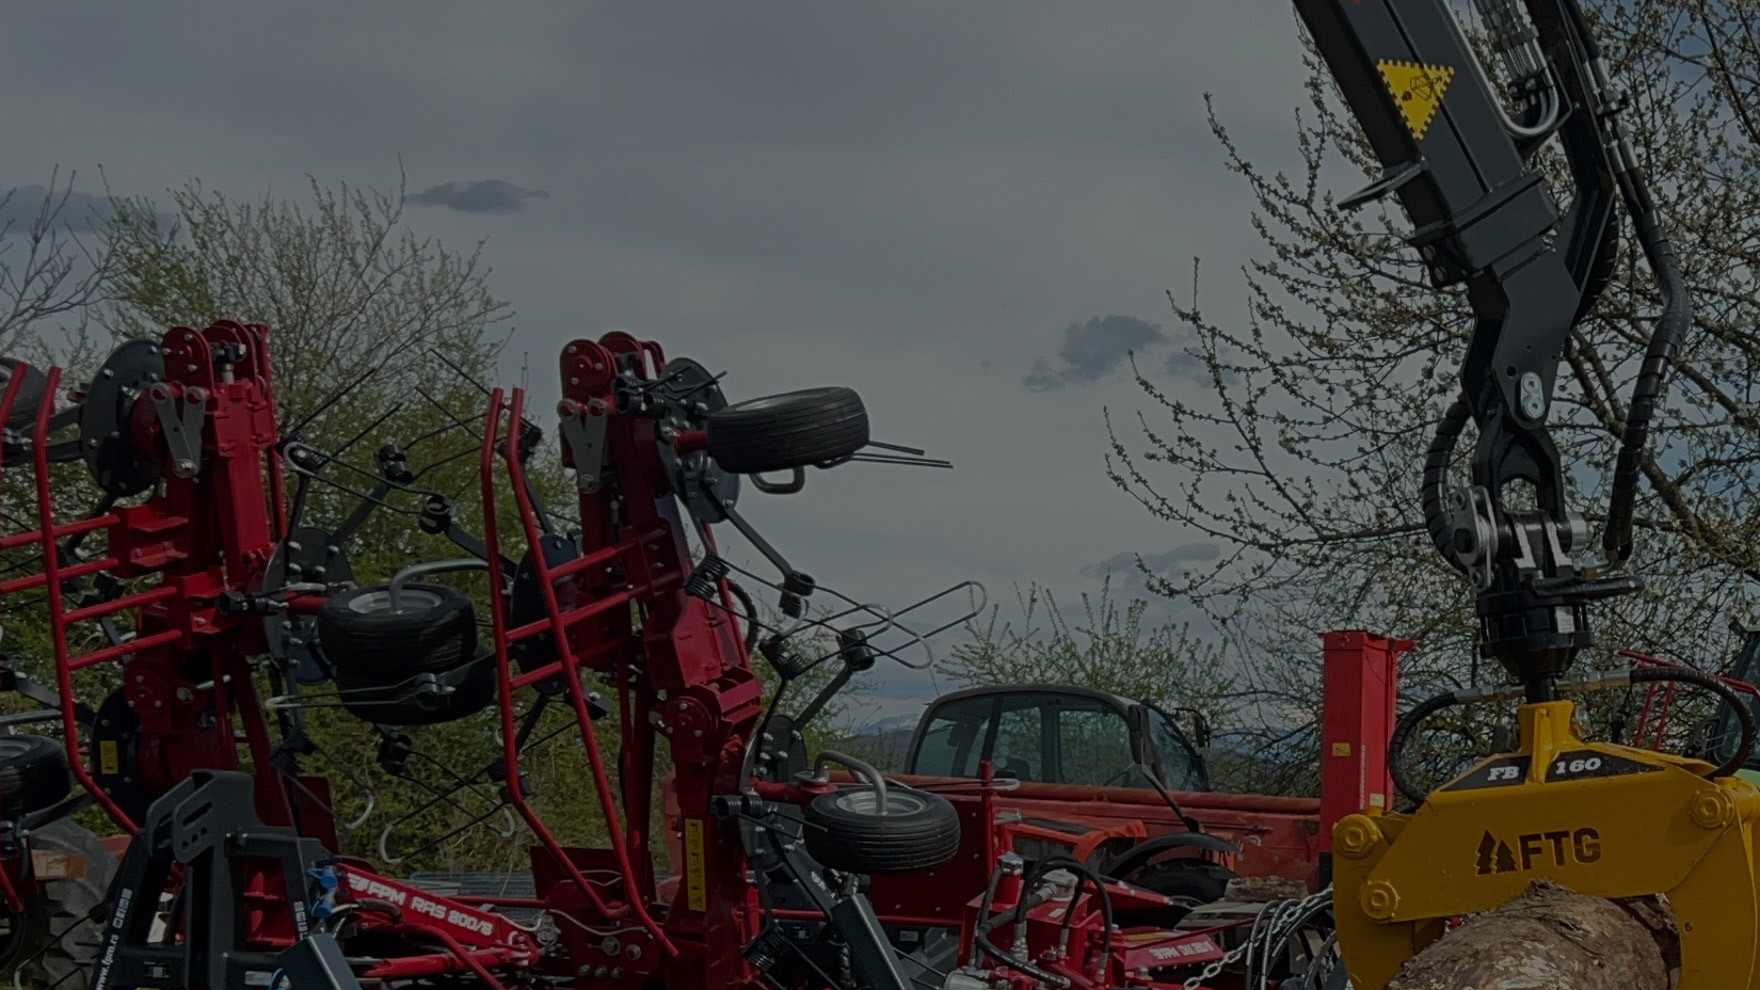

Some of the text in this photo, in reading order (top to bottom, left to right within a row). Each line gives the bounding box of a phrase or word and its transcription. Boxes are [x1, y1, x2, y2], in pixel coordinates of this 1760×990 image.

[1487, 757, 1601, 781] FB 160
[1517, 828, 1601, 871] FTG
[367, 879, 407, 906] FPM
[410, 896, 447, 920] RAS
